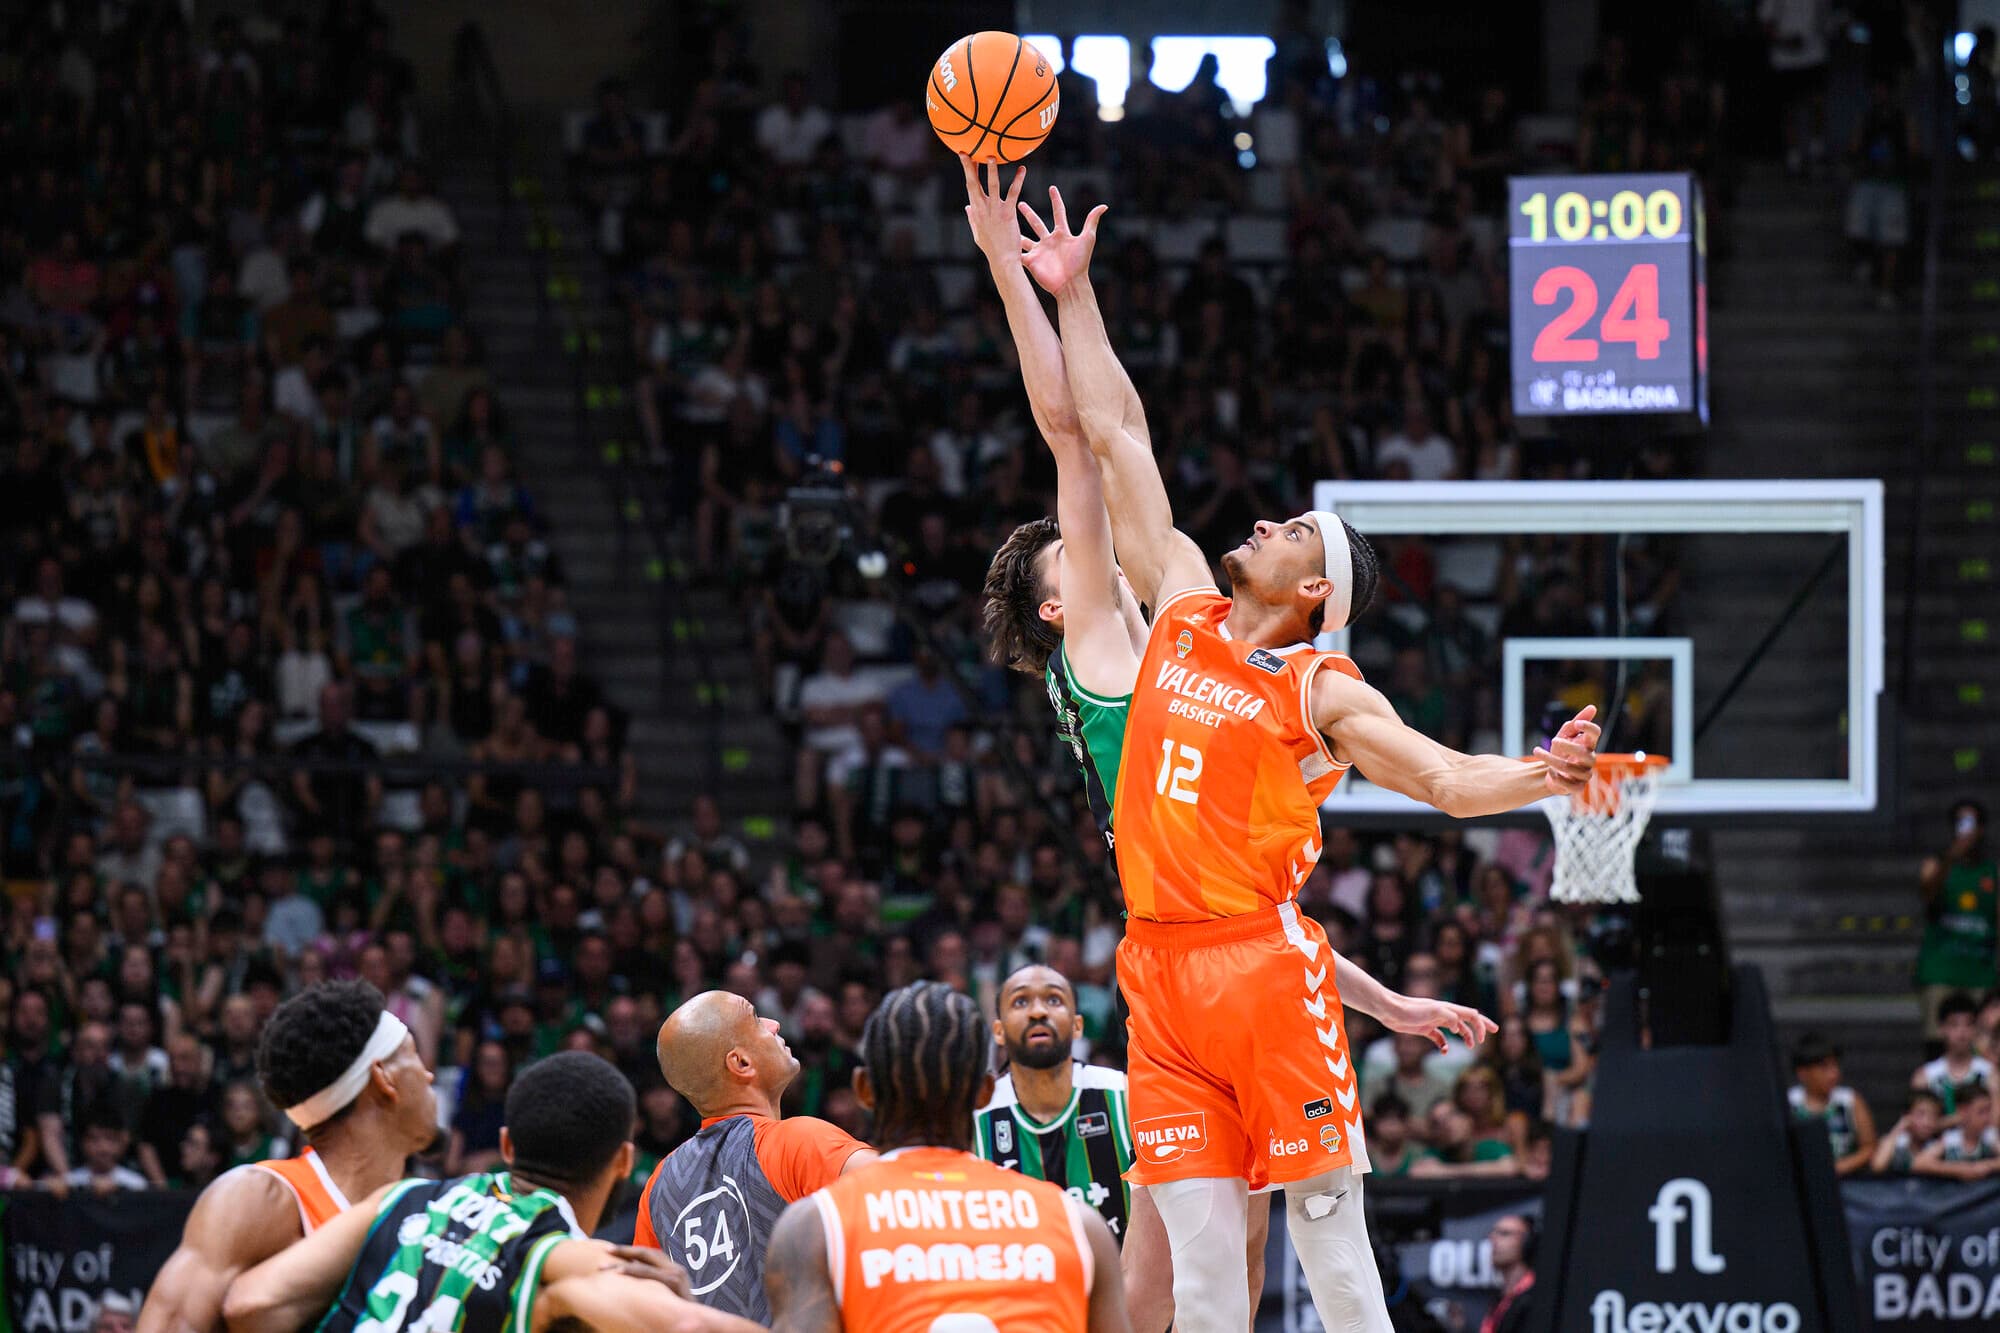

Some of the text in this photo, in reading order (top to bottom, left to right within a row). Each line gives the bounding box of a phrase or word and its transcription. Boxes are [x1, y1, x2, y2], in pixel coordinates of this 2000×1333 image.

[1520, 189, 1682, 242] 10:00
[1532, 264, 1670, 362] 24
[1155, 660, 1266, 721] VALENCIA
[1168, 698, 1226, 729] BASKET
[1156, 738, 1204, 805] 12
[1308, 1106, 1327, 1117] acb
[1138, 1125, 1200, 1147] PULEVA
[865, 1189, 1039, 1232] MONTERO
[685, 1209, 734, 1270] 54
[1872, 1227, 1952, 1272] City
[861, 1243, 1056, 1288] PAMESA
